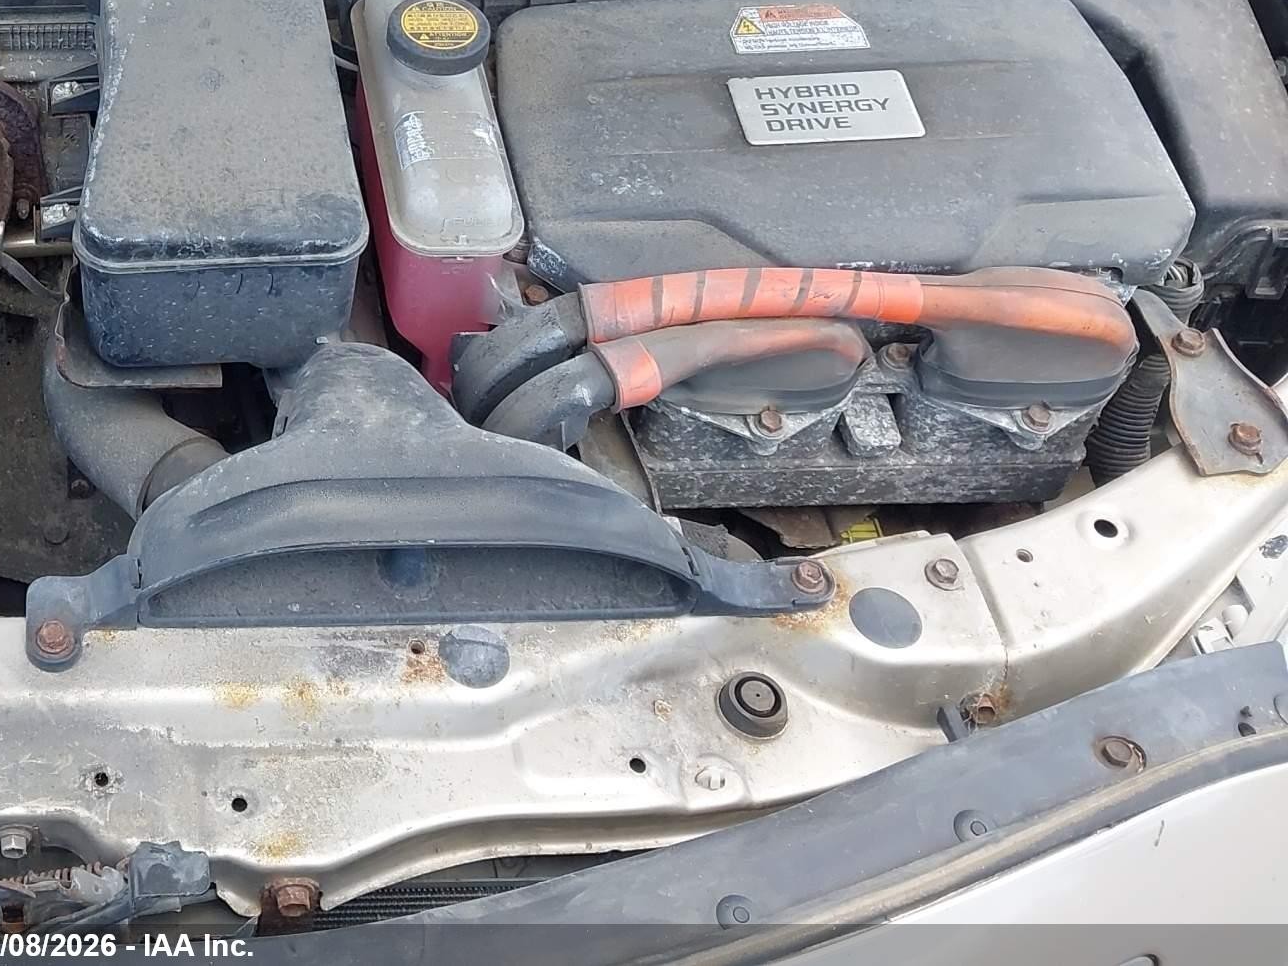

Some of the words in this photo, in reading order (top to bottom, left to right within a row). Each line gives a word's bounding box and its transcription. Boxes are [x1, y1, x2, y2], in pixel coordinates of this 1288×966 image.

[754, 83, 861, 101] HYBRID
[760, 97, 890, 117] SYNERGY
[765, 116, 853, 133] DRIVE
